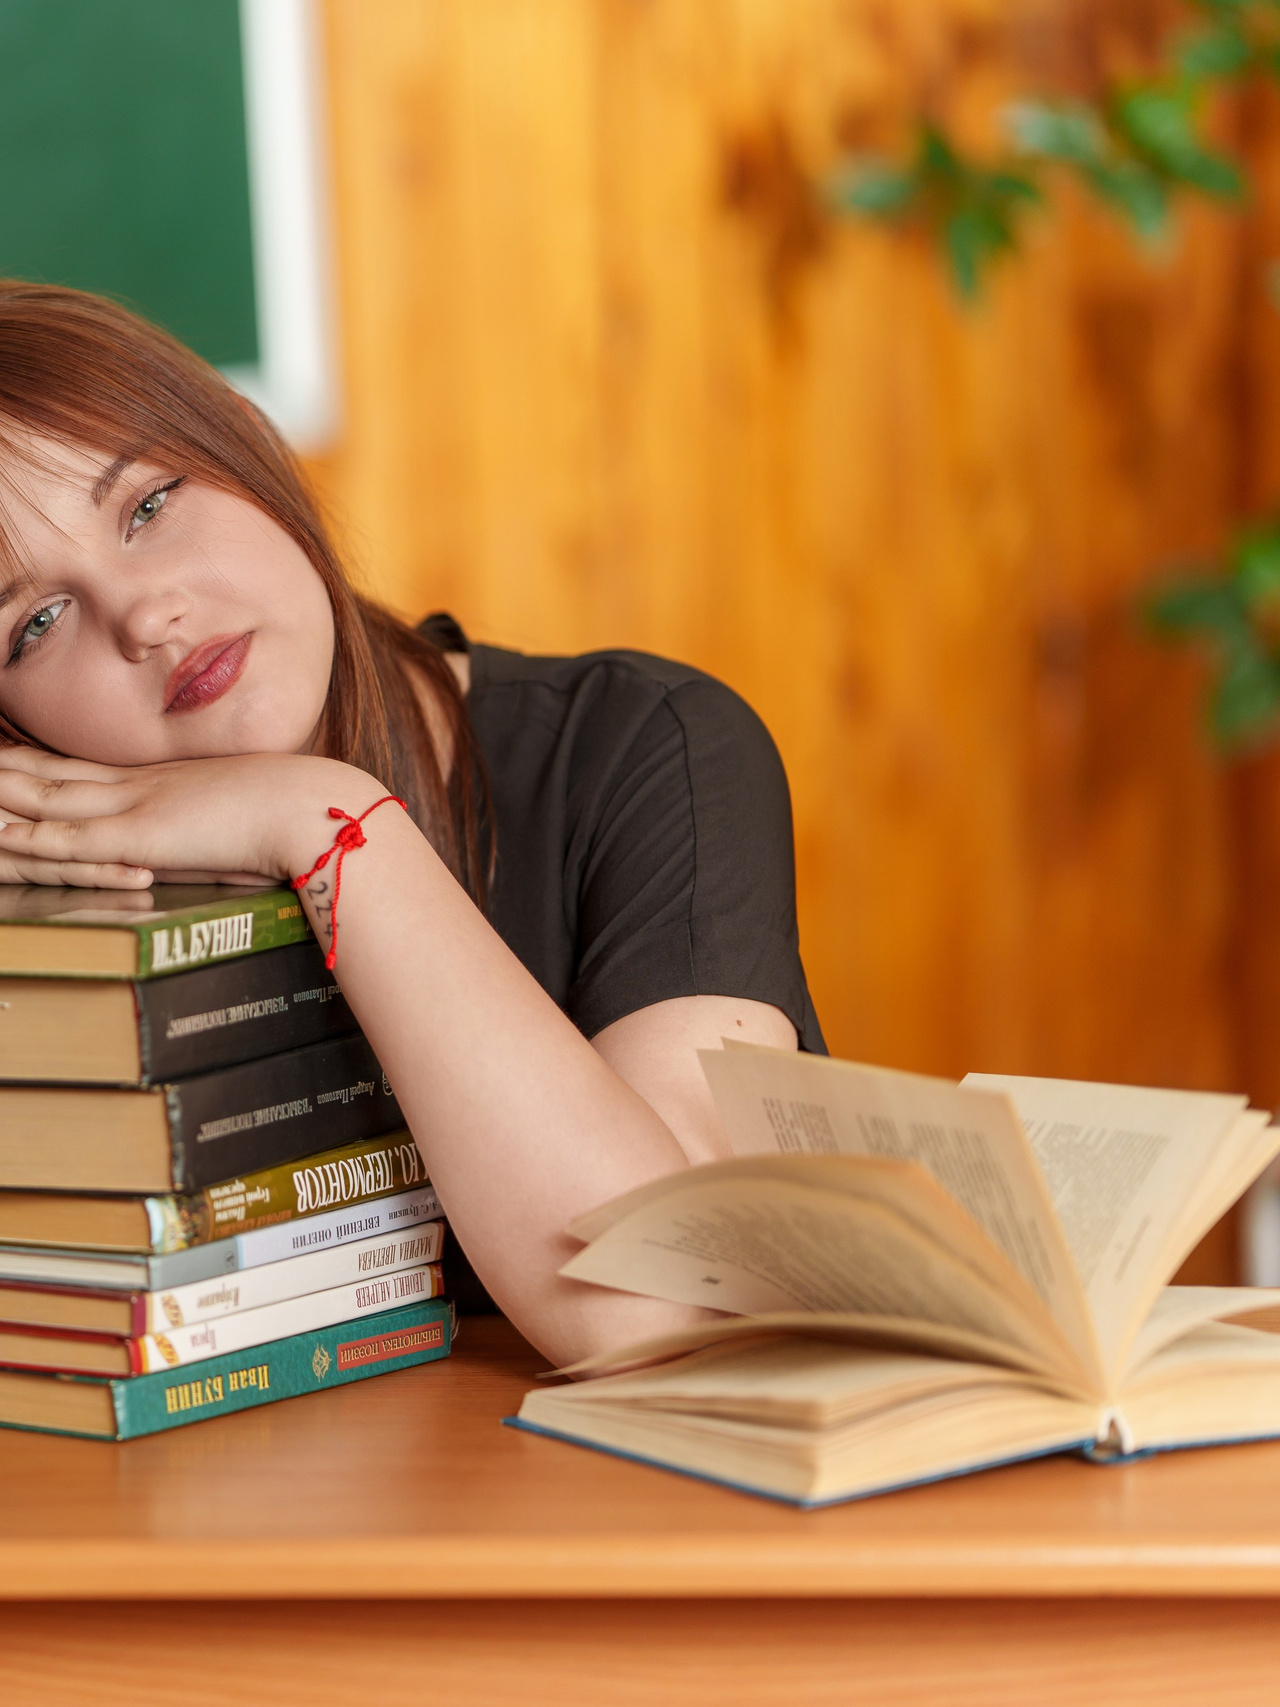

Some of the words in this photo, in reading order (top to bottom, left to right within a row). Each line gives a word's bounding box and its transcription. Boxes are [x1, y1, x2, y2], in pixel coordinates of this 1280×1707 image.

[277, 905, 304, 920] МИРОВА
[189, 912, 254, 962] БУНИН
[317, 1088, 350, 1104] Платонов
[350, 1081, 375, 1101] Андрей
[292, 1149, 395, 1213] ЛЕРМОНТОВ
[388, 1203, 418, 1221] Пушкин
[292, 1228, 332, 1249] ОНЕГИН
[335, 1215, 381, 1241] ЕВГЕНИЙ
[358, 1244, 397, 1272] ЦВЕТАЕВА
[399, 1234, 434, 1264] МАРИНА
[355, 1279, 392, 1309] АНДРЕЕВ
[394, 1271, 426, 1299] ЛЕОНИД
[339, 1343, 380, 1363] ПОЭЗИИ
[381, 1326, 441, 1353] БИБЛИОТЕКА
[228, 1364, 270, 1391] Иван
[165, 1375, 225, 1414] БУНИН
